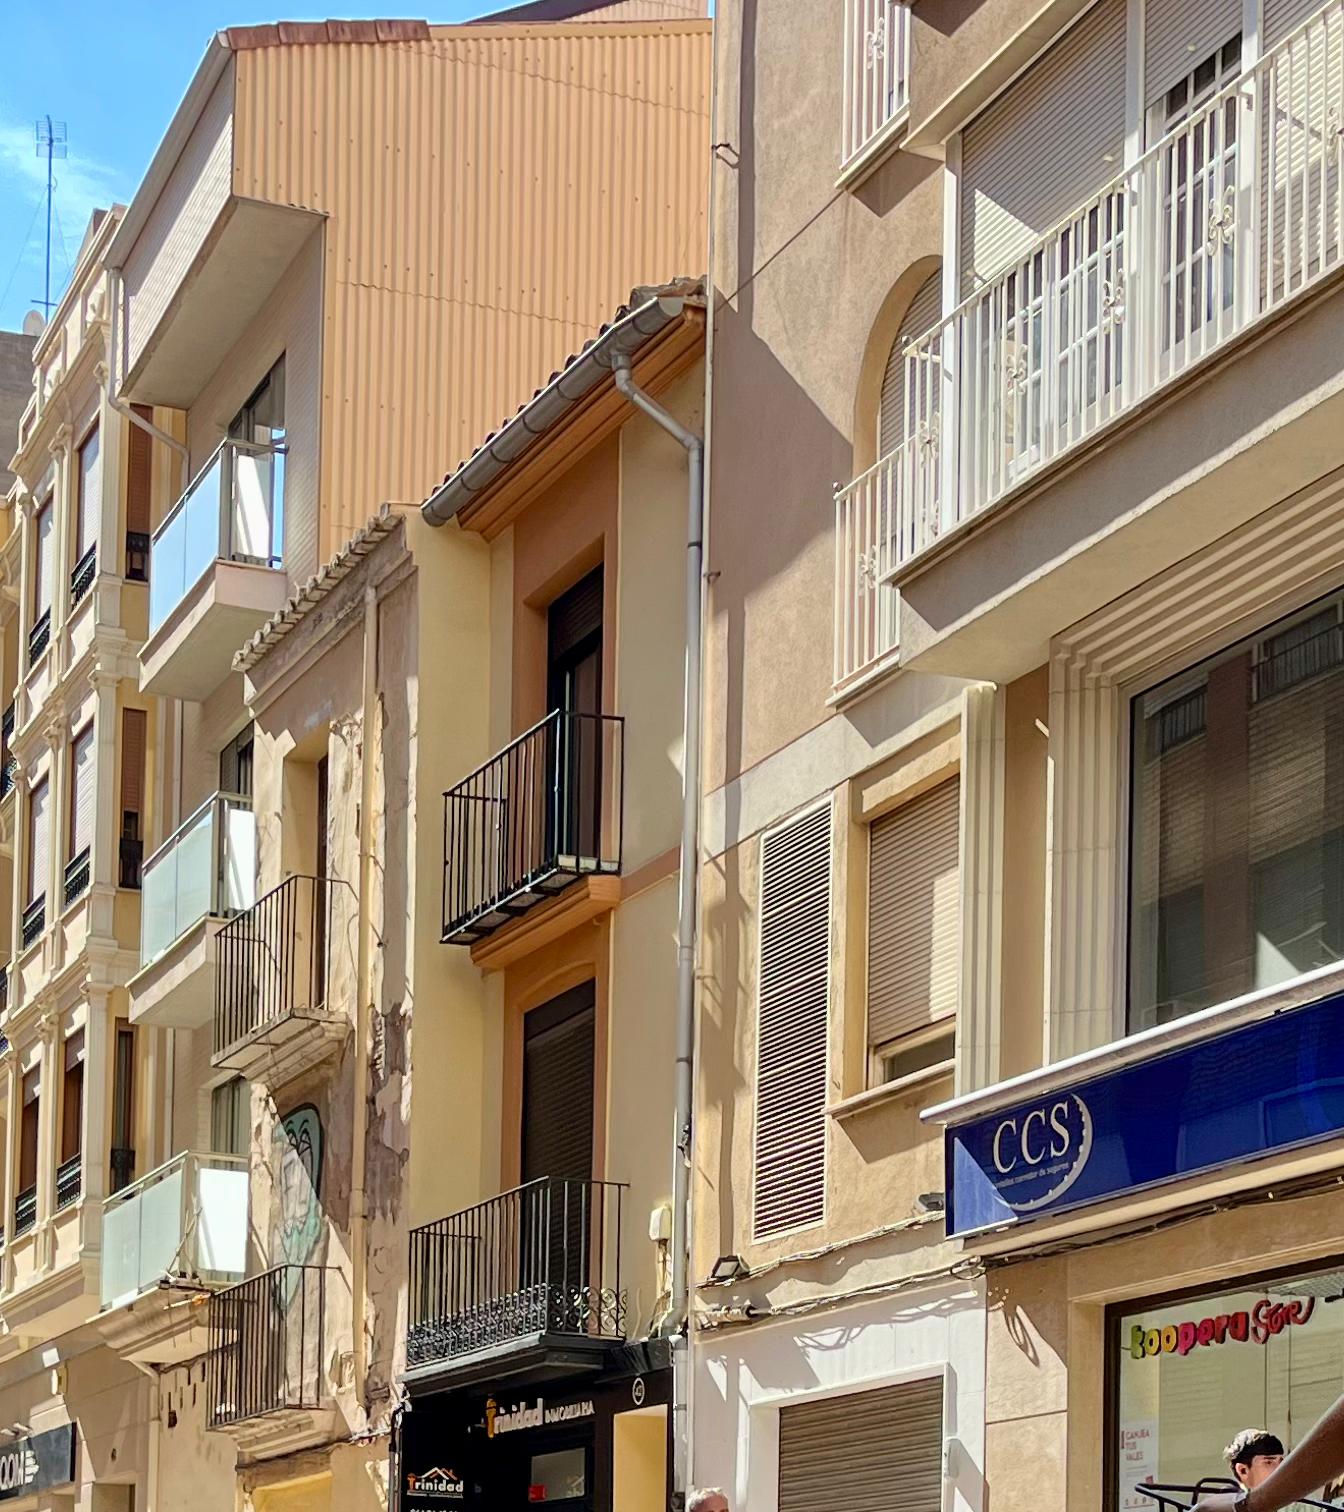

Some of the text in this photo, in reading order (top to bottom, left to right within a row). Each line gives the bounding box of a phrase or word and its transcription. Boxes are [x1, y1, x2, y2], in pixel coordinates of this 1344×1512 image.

[993, 1101, 1070, 1174] CCS
[486, 1397, 544, 1438] Trinidad
[407, 1474, 464, 1493] Trinidad
